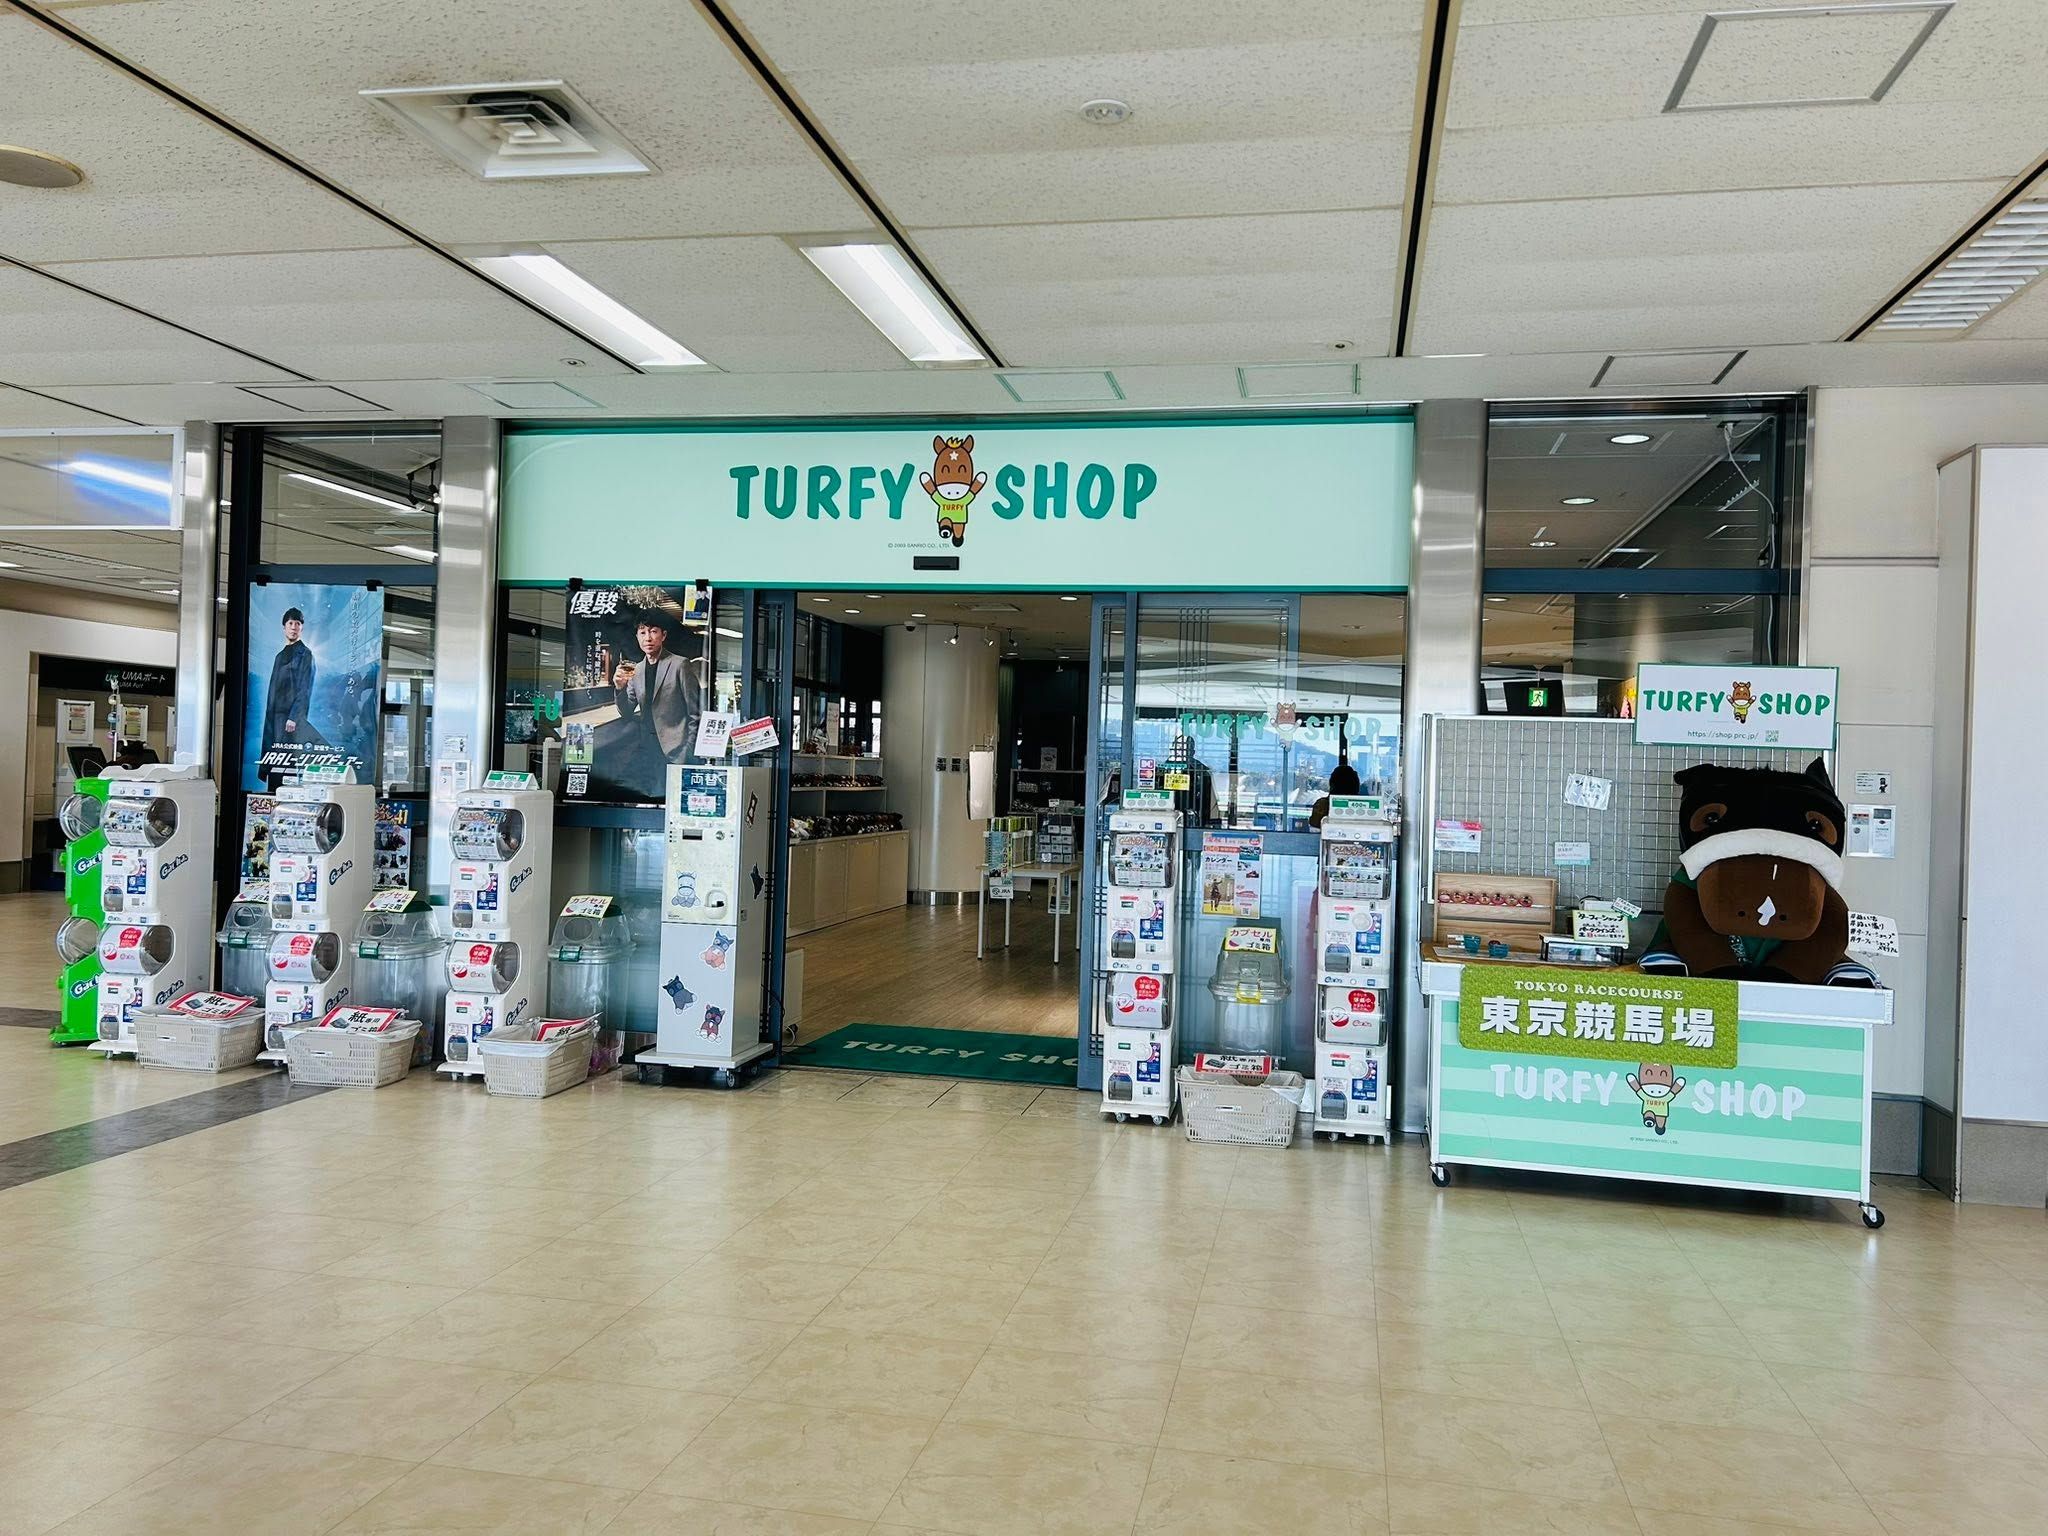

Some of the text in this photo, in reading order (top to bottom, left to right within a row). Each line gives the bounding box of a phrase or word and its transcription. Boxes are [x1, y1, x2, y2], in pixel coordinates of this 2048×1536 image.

[729, 462, 1157, 519] TURFY SHOP
[570, 591, 619, 614] 優駿
[1643, 690, 1830, 716] TURFY SHOP
[1181, 713, 1381, 741] TURFY SHOP
[690, 772, 718, 786] 両替
[570, 897, 608, 905] カプセル
[1230, 929, 1273, 938] カプセル
[1513, 980, 1683, 1001] TOKYO RACECOURSE
[1479, 995, 1716, 1048] 東京競馬場
[842, 1040, 985, 1059] TURFY
[1490, 1064, 1806, 1121] TURFY SHOP
